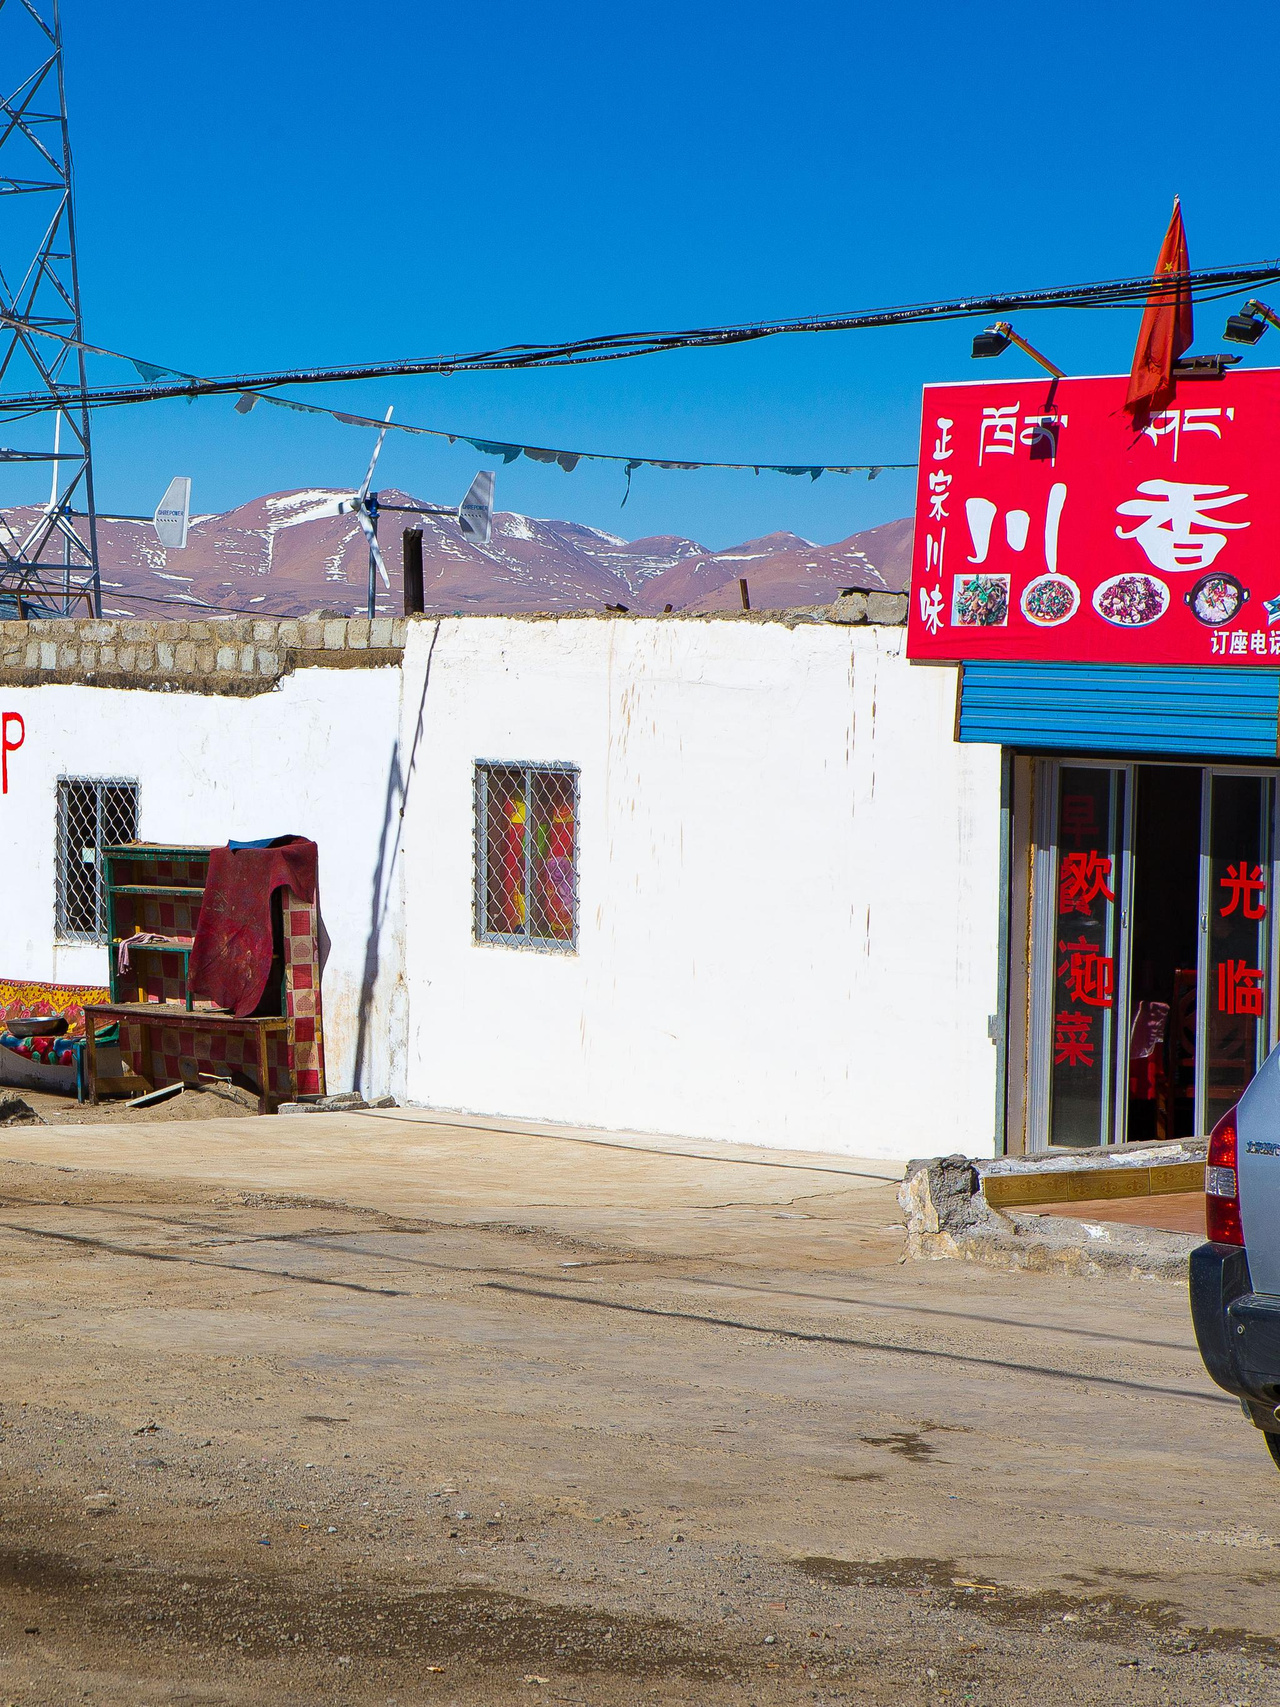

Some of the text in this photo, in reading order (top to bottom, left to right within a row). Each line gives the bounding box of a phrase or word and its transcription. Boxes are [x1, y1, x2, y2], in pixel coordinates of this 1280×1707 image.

[919, 416, 954, 636] 正宗川味
[1218, 860, 1267, 1017] 光临
